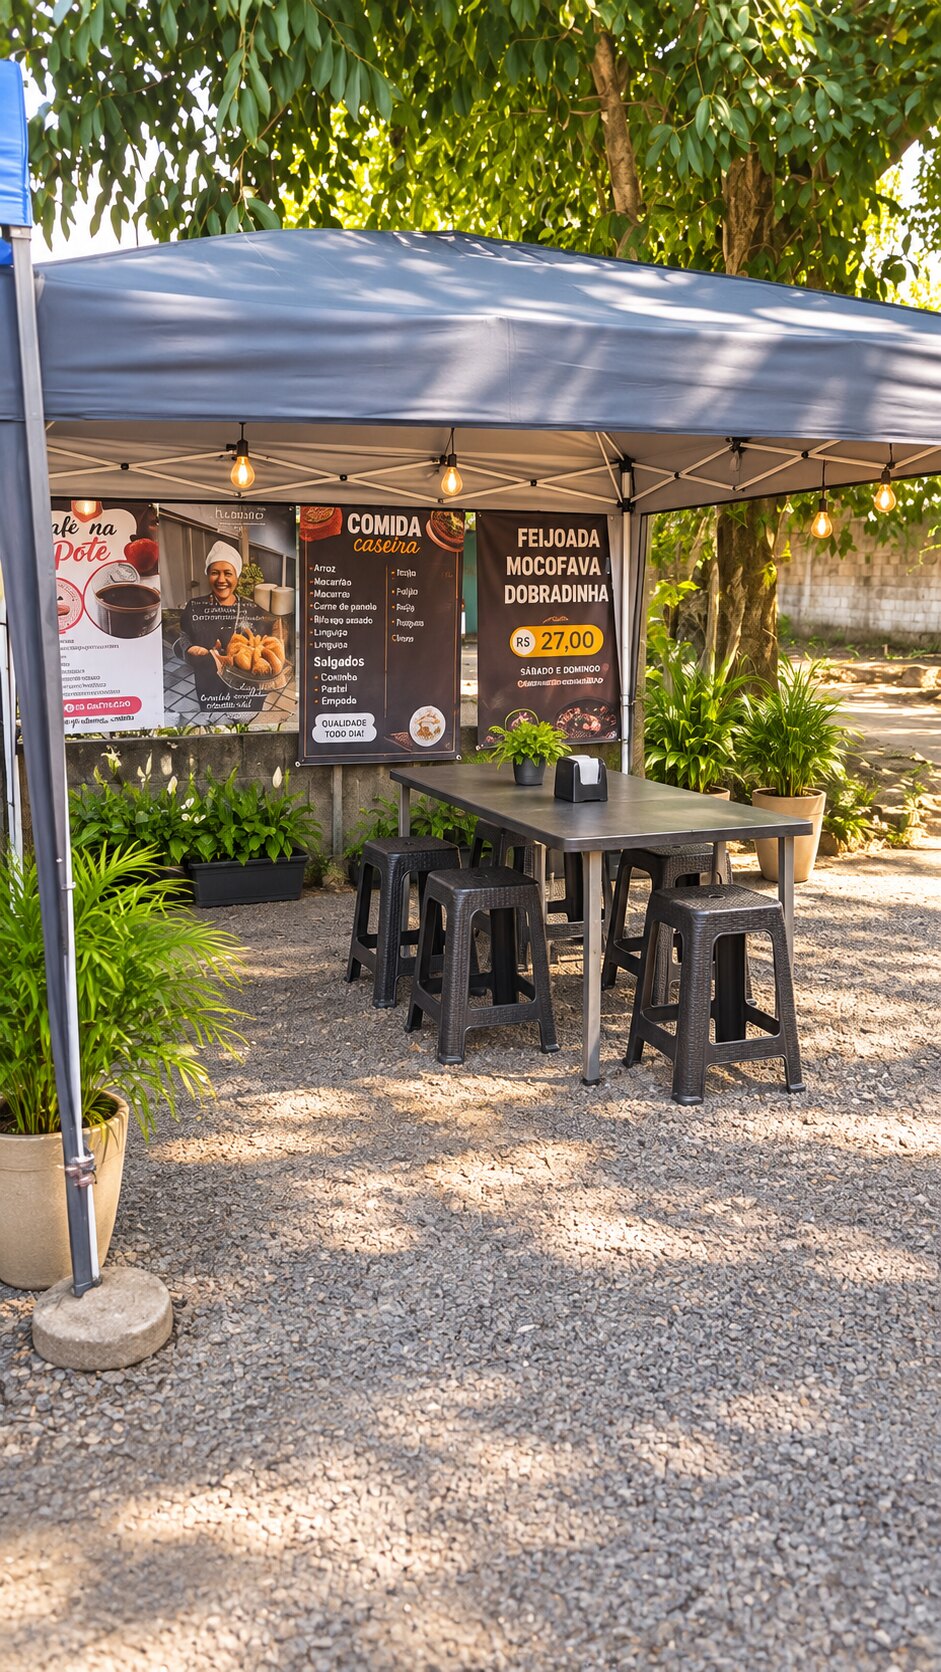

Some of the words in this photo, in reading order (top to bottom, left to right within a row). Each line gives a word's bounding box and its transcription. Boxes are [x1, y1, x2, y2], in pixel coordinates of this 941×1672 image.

[52, 516, 79, 537] afé
[89, 523, 117, 535] na
[348, 513, 422, 537] COMIDA
[354, 537, 420, 554] caseira
[517, 528, 600, 548] FEIJOADA
[53, 537, 111, 570] Pote
[314, 564, 336, 573] Arroz
[506, 556, 602, 576] MOCOFAVA
[504, 584, 609, 604] DOBRADINHA
[541, 631, 594, 652] 27,00
[314, 655, 365, 670] Salgados
[322, 719, 367, 728] QUALIDADE
[325, 730, 347, 738] TODO
